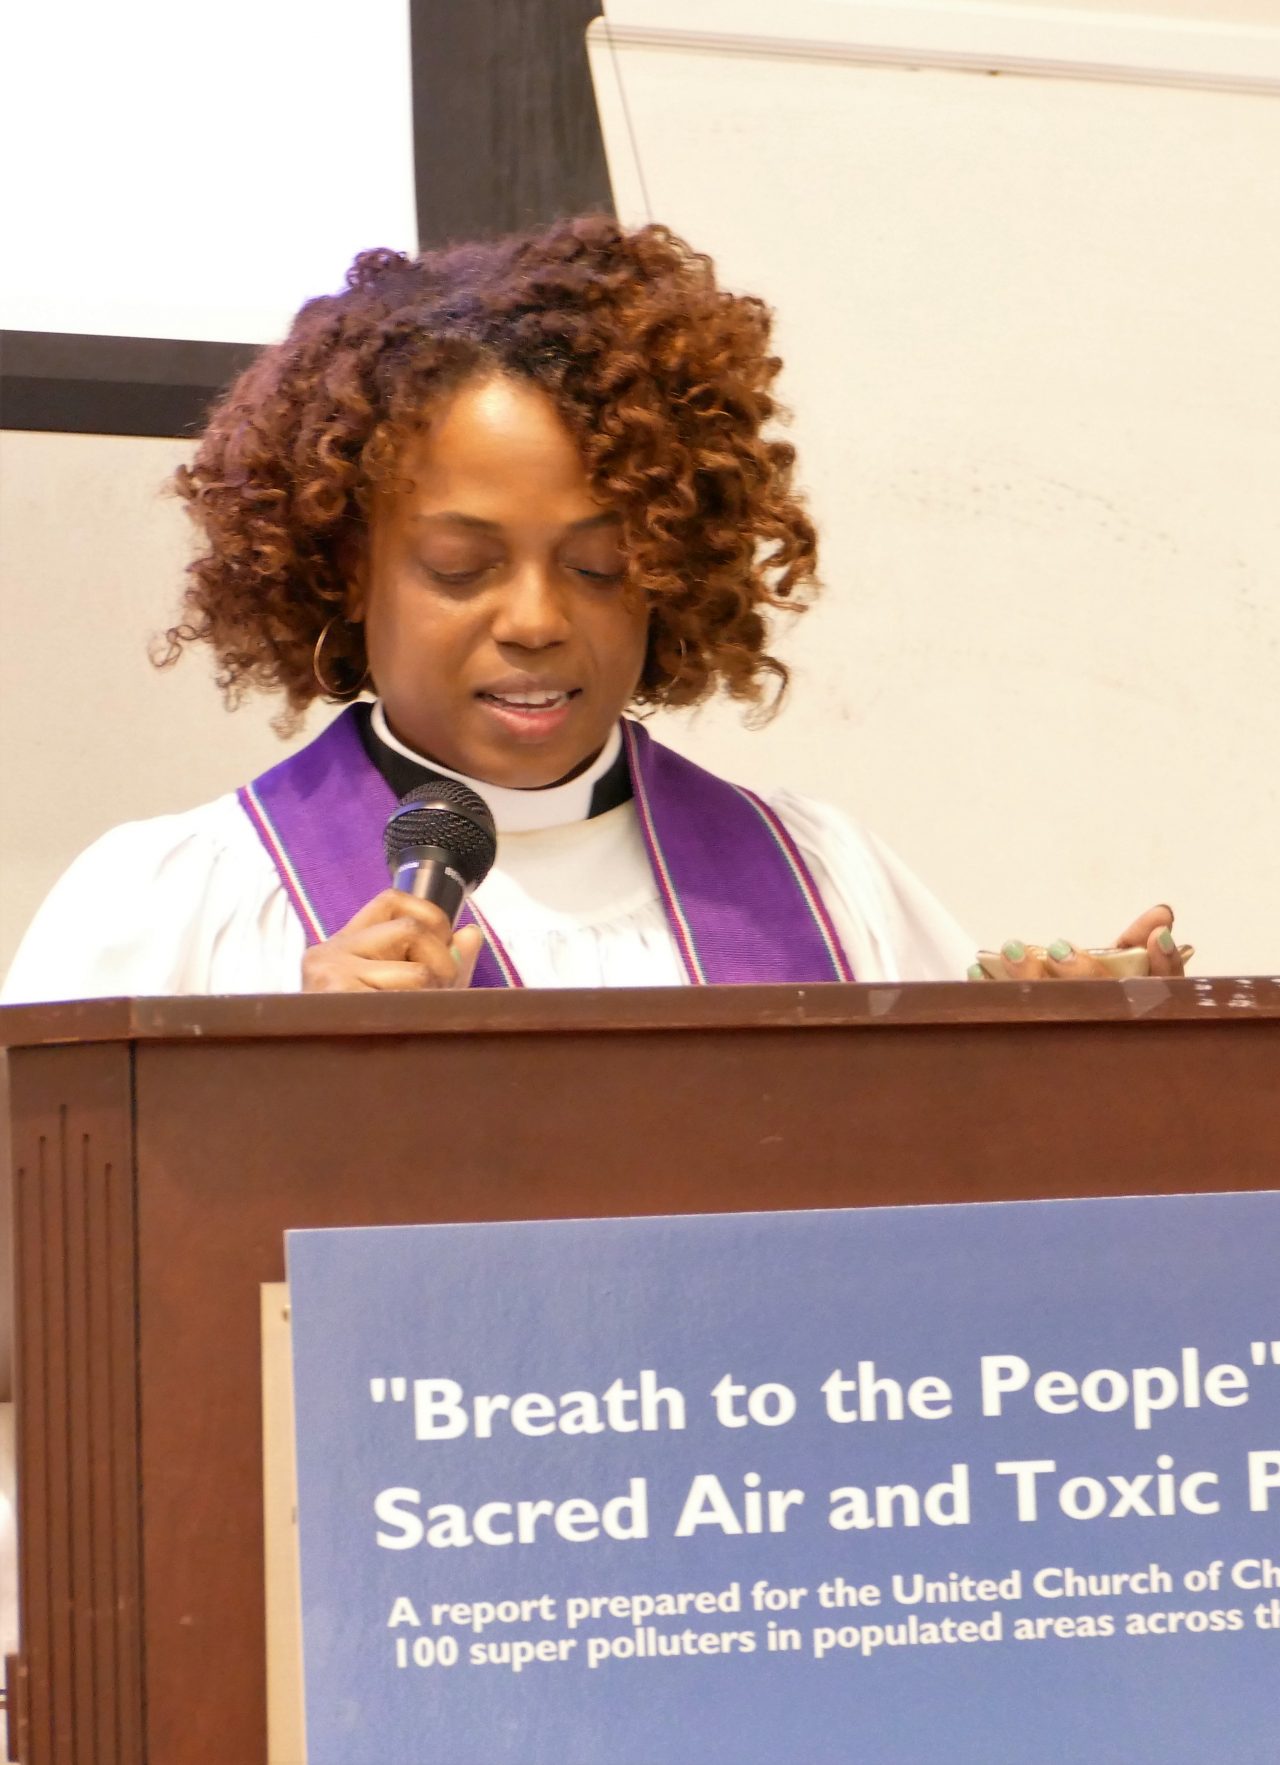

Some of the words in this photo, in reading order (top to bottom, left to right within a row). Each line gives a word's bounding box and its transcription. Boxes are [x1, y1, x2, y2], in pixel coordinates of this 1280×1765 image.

[370, 1370, 685, 1441] "Breath
[711, 1374, 796, 1428] to
[821, 1361, 952, 1424] the
[374, 1478, 648, 1551] Sacred
[675, 1472, 804, 1536] Air
[829, 1464, 969, 1531] and
[996, 1455, 1219, 1522] Toxic
[387, 1597, 421, 1627] A
[432, 1595, 556, 1633] report
[567, 1583, 740, 1628] prepared
[751, 1580, 807, 1611] for
[817, 1578, 880, 1608] the
[893, 1570, 1021, 1604] United
[1034, 1564, 1172, 1598] Church
[1184, 1561, 1223, 1592] of
[396, 1636, 458, 1668] 100
[470, 1639, 577, 1672] super
[588, 1627, 756, 1668] polluters
[768, 1621, 801, 1651] in
[814, 1612, 1002, 1658] populated
[1014, 1615, 1114, 1641] areas
[1126, 1609, 1243, 1636] across
